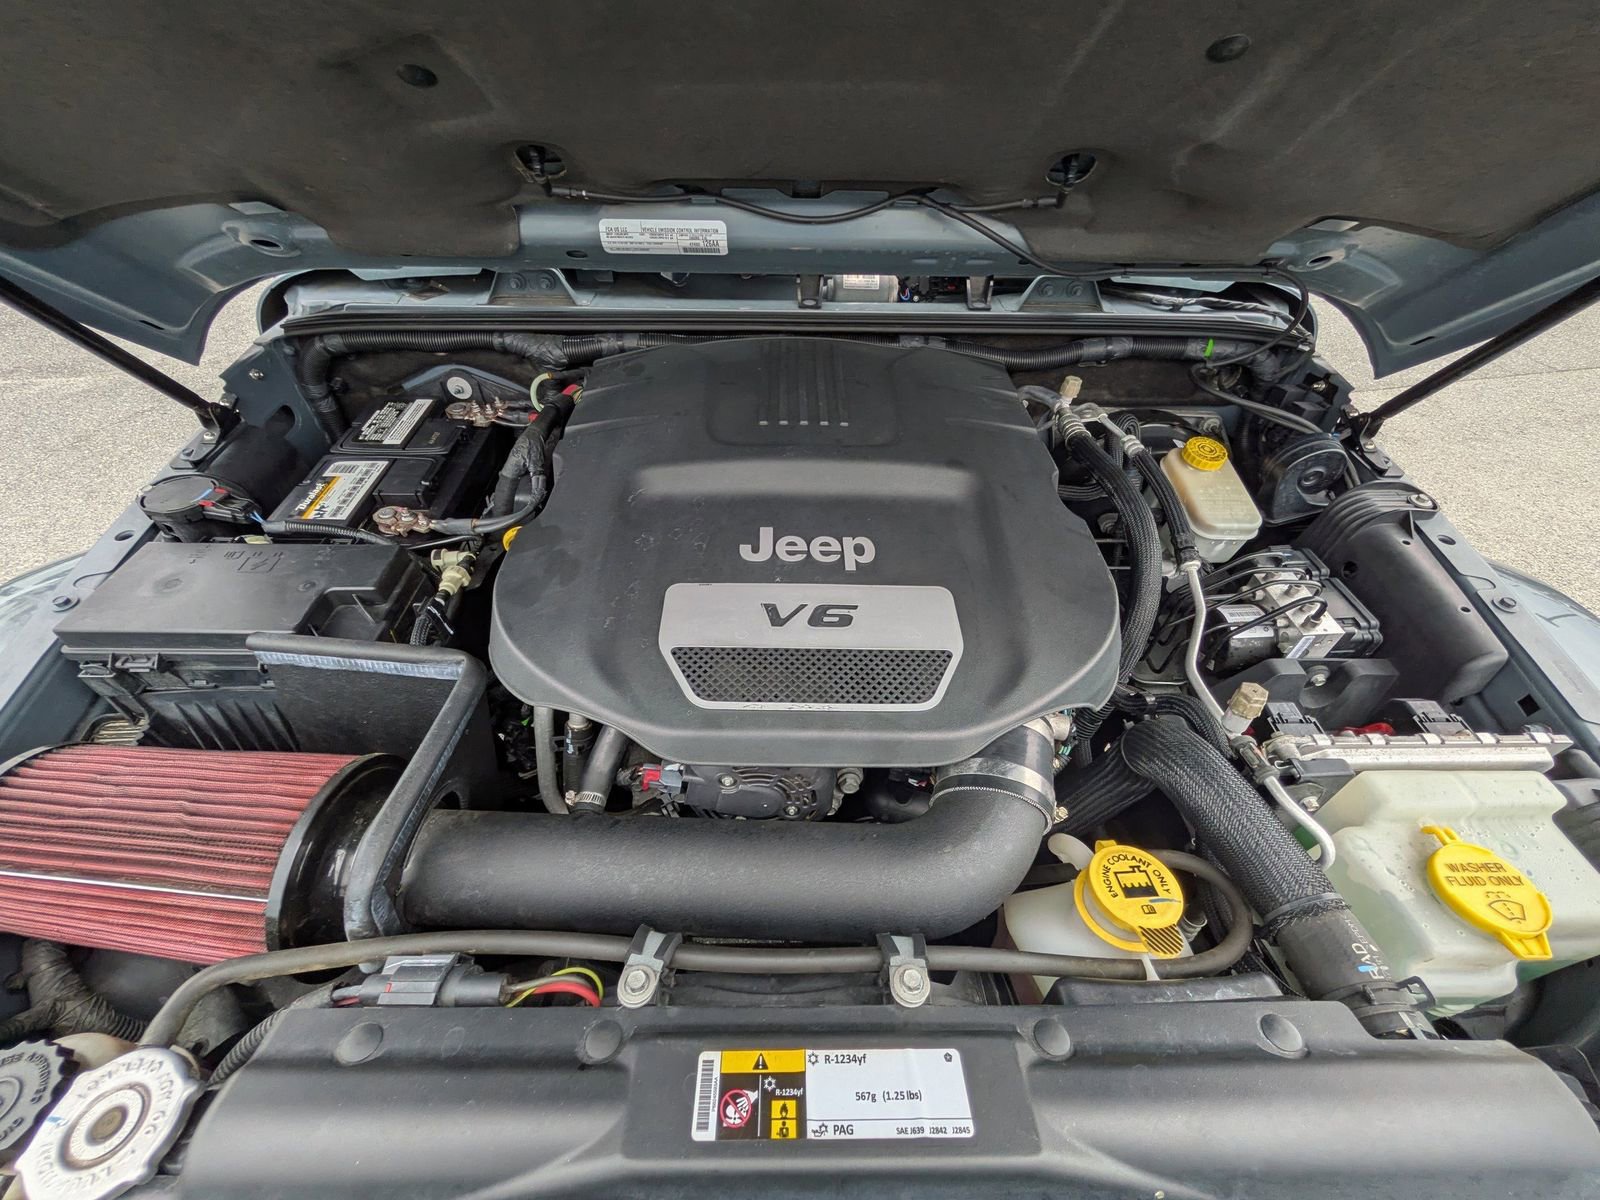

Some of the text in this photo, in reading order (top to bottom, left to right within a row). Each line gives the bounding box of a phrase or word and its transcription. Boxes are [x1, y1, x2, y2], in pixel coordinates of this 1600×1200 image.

[295, 482, 327, 512] Duralast
[739, 526, 876, 571] Jeep
[760, 603, 859, 628] V6
[1444, 862, 1507, 873] WASHER
[1101, 853, 1172, 898] ENGINE COOLANT ONLY
[1444, 876, 1525, 887] FLUID ONLY
[824, 1053, 867, 1066] R-1234yf
[775, 1087, 804, 1097] R-1234yf
[855, 1089, 922, 1103] 567g (1.25 lbs)
[833, 1124, 854, 1136] PAG
[896, 1126, 971, 1135] SAE J639 J2842 J2845
